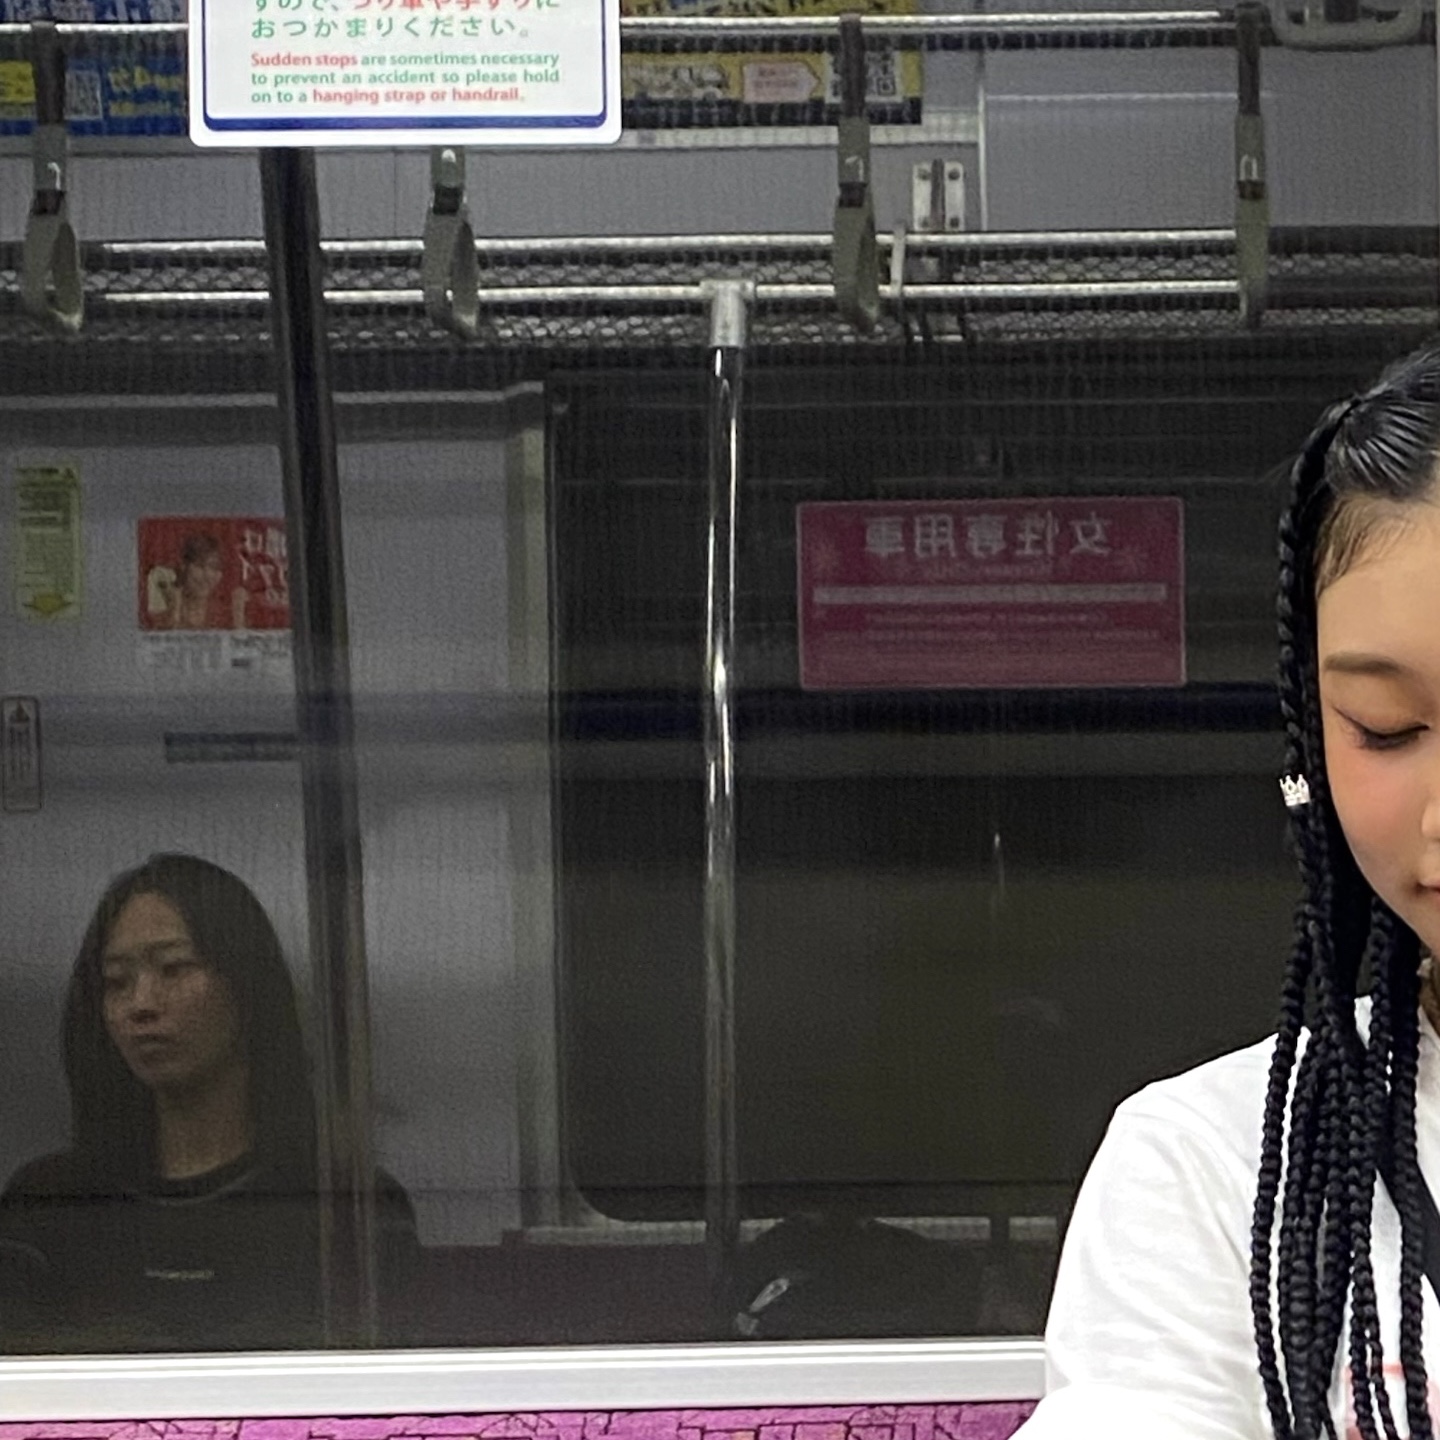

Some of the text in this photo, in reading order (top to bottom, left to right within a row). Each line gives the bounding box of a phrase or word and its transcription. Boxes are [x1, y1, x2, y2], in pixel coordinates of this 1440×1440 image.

[252, 17, 529, 39] おつかまりください。
[251, 52, 560, 69] Sudden stops are sometimes necessary
[251, 68, 560, 88] to prevent an accident so please hold
[251, 92, 272, 103] on
[277, 90, 293, 103] to
[298, 92, 308, 103] a
[312, 88, 380, 105] hanging
[384, 89, 426, 105] strap
[430, 91, 447, 102] or
